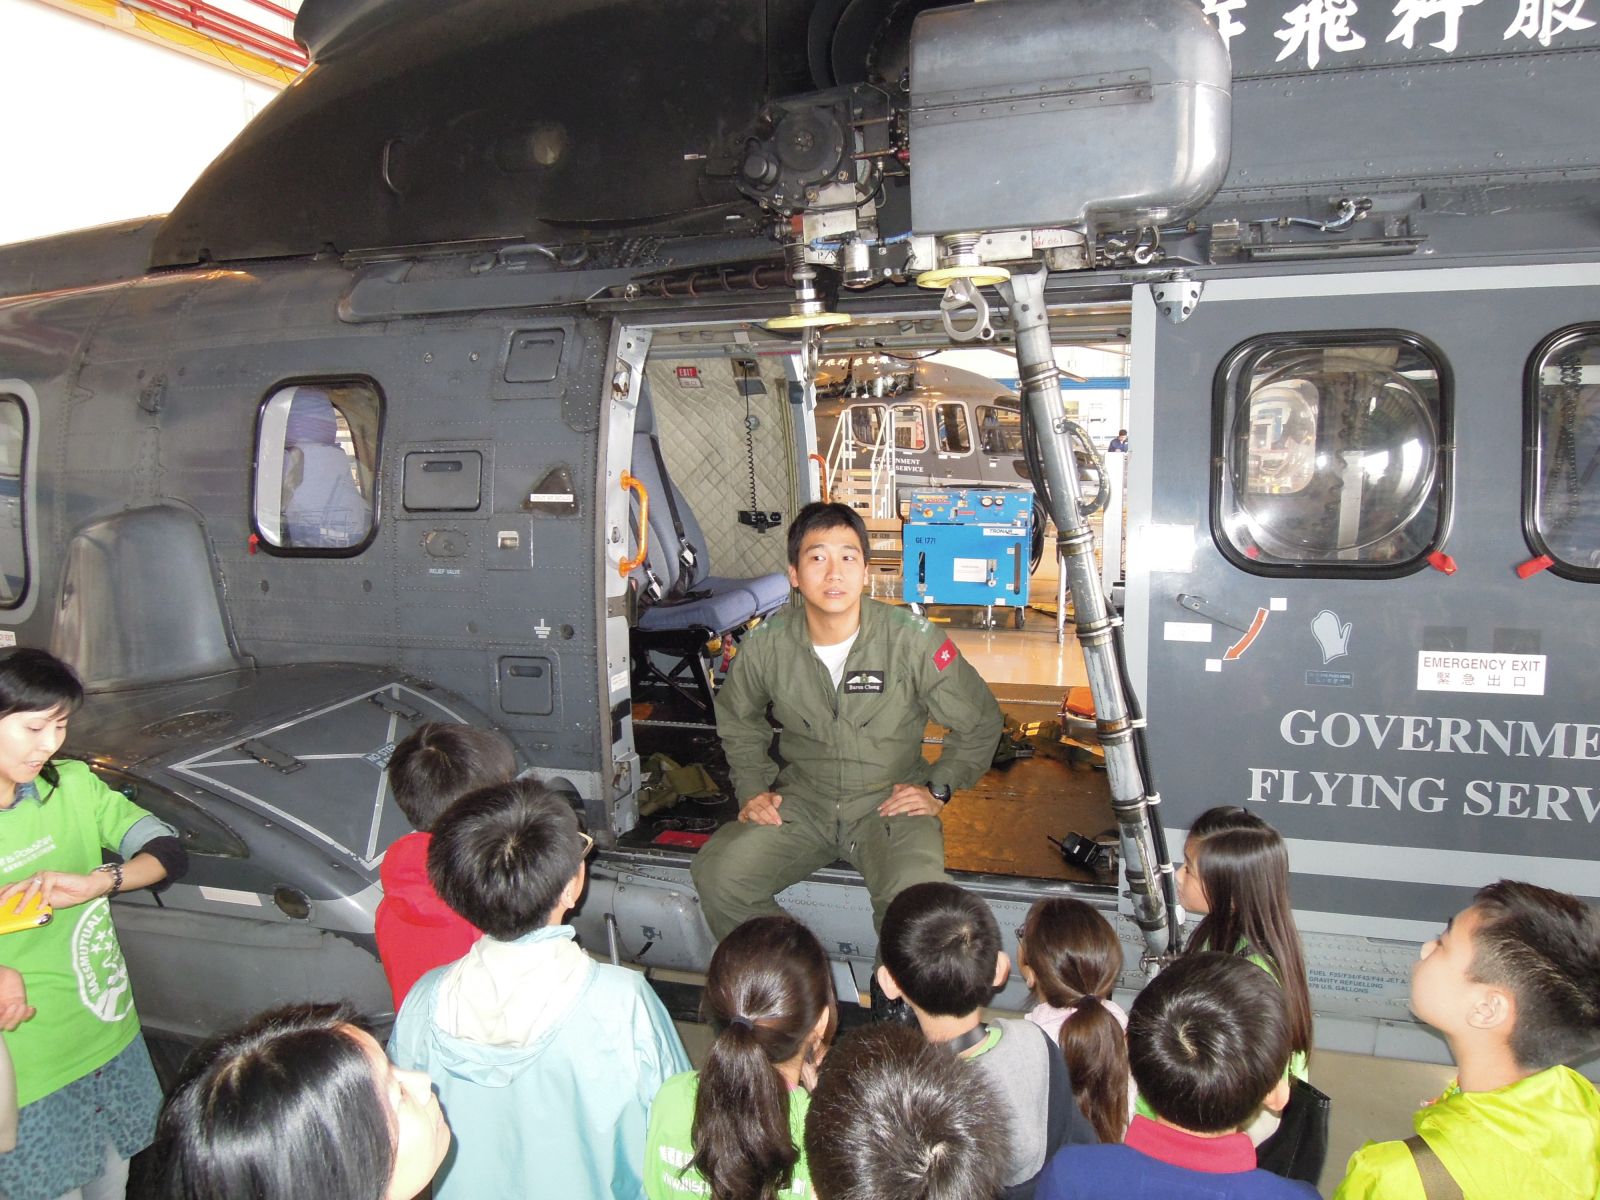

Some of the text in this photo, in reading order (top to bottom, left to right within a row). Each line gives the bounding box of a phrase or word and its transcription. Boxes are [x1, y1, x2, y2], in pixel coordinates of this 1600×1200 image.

[896, 465, 924, 473] SERVICE
[1423, 656, 1541, 672] EMERGENCY EXIT
[1437, 671, 1526, 688] 緊急出口
[1280, 709, 1600, 760] GOVERNME
[1247, 767, 1449, 813] FLYING
[78, 914, 104, 997] MASSMUTUAL
[1309, 969, 1327, 977] FUEL
[1308, 976, 1383, 989] GRAVITY REFUELLING
[1335, 985, 1369, 994] GALLONS
